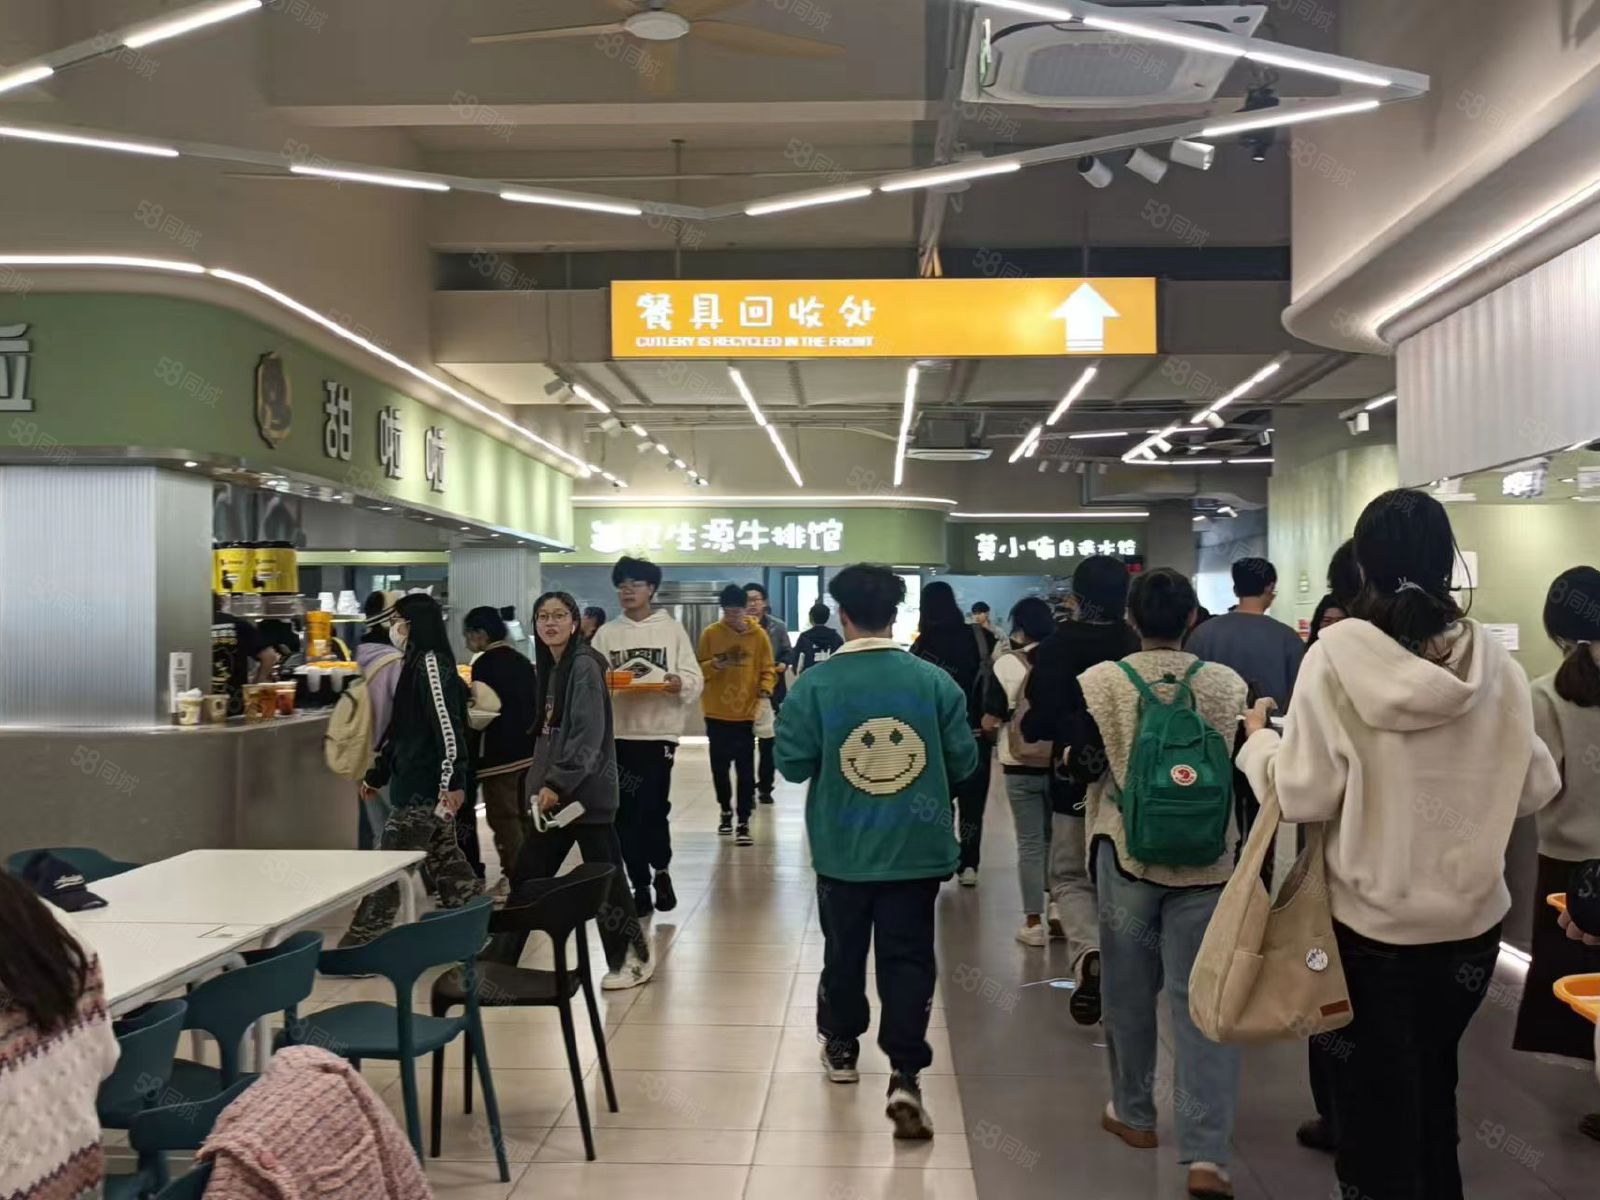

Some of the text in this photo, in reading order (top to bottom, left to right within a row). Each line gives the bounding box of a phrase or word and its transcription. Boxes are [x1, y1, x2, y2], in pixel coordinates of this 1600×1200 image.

[636, 293, 876, 331] 餐具回收处
[635, 336, 873, 348] CUTLERY IS RECYCLED IN THE FRONT
[322, 379, 447, 493] 甜啦啦
[590, 518, 844, 553] 生源牛排馆
